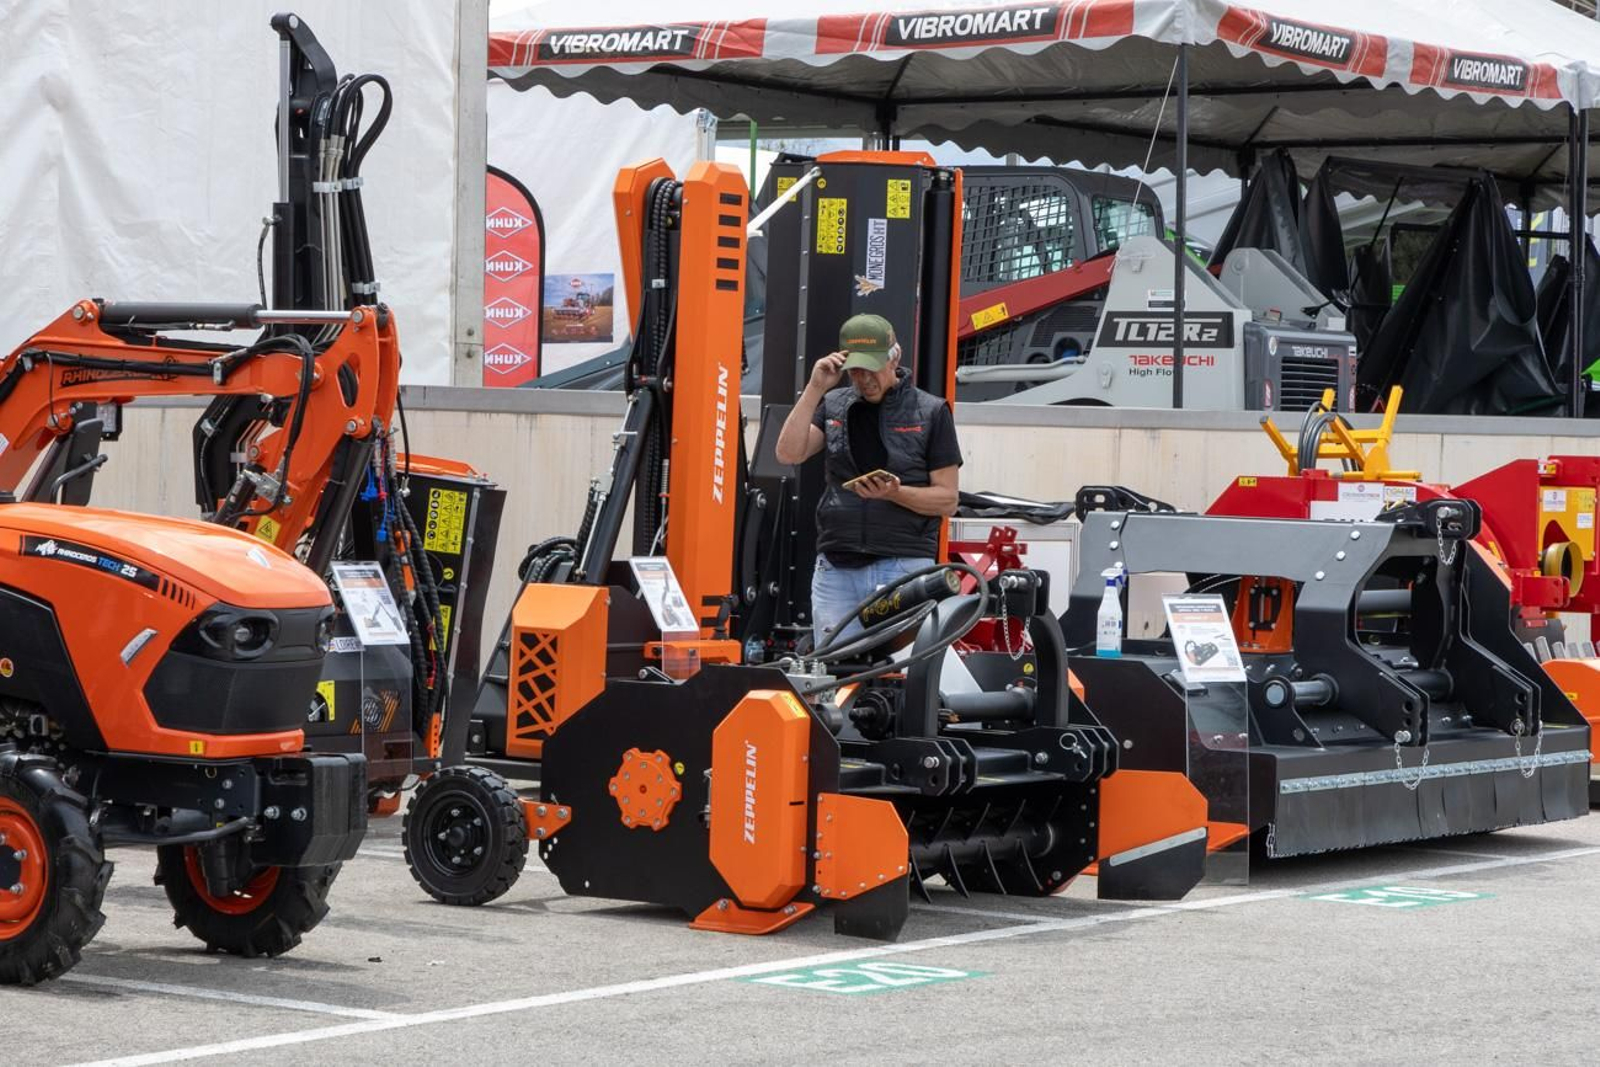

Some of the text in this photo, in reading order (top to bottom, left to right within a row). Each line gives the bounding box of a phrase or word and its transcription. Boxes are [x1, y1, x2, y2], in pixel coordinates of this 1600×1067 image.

[899, 8, 1050, 40] VIBROMART
[550, 29, 689, 55] VIBROMART
[1270, 22, 1350, 59] VIBROMART
[1453, 58, 1524, 86] VIBROMART
[868, 220, 886, 280] MONEGROS HT
[1129, 368, 1175, 377] High Flo
[712, 366, 728, 505] ZEPPELIN
[98, 556, 121, 572] TECH
[121, 564, 138, 578] 25
[744, 743, 757, 845] ZEPPELIN
[750, 962, 968, 993] E20
